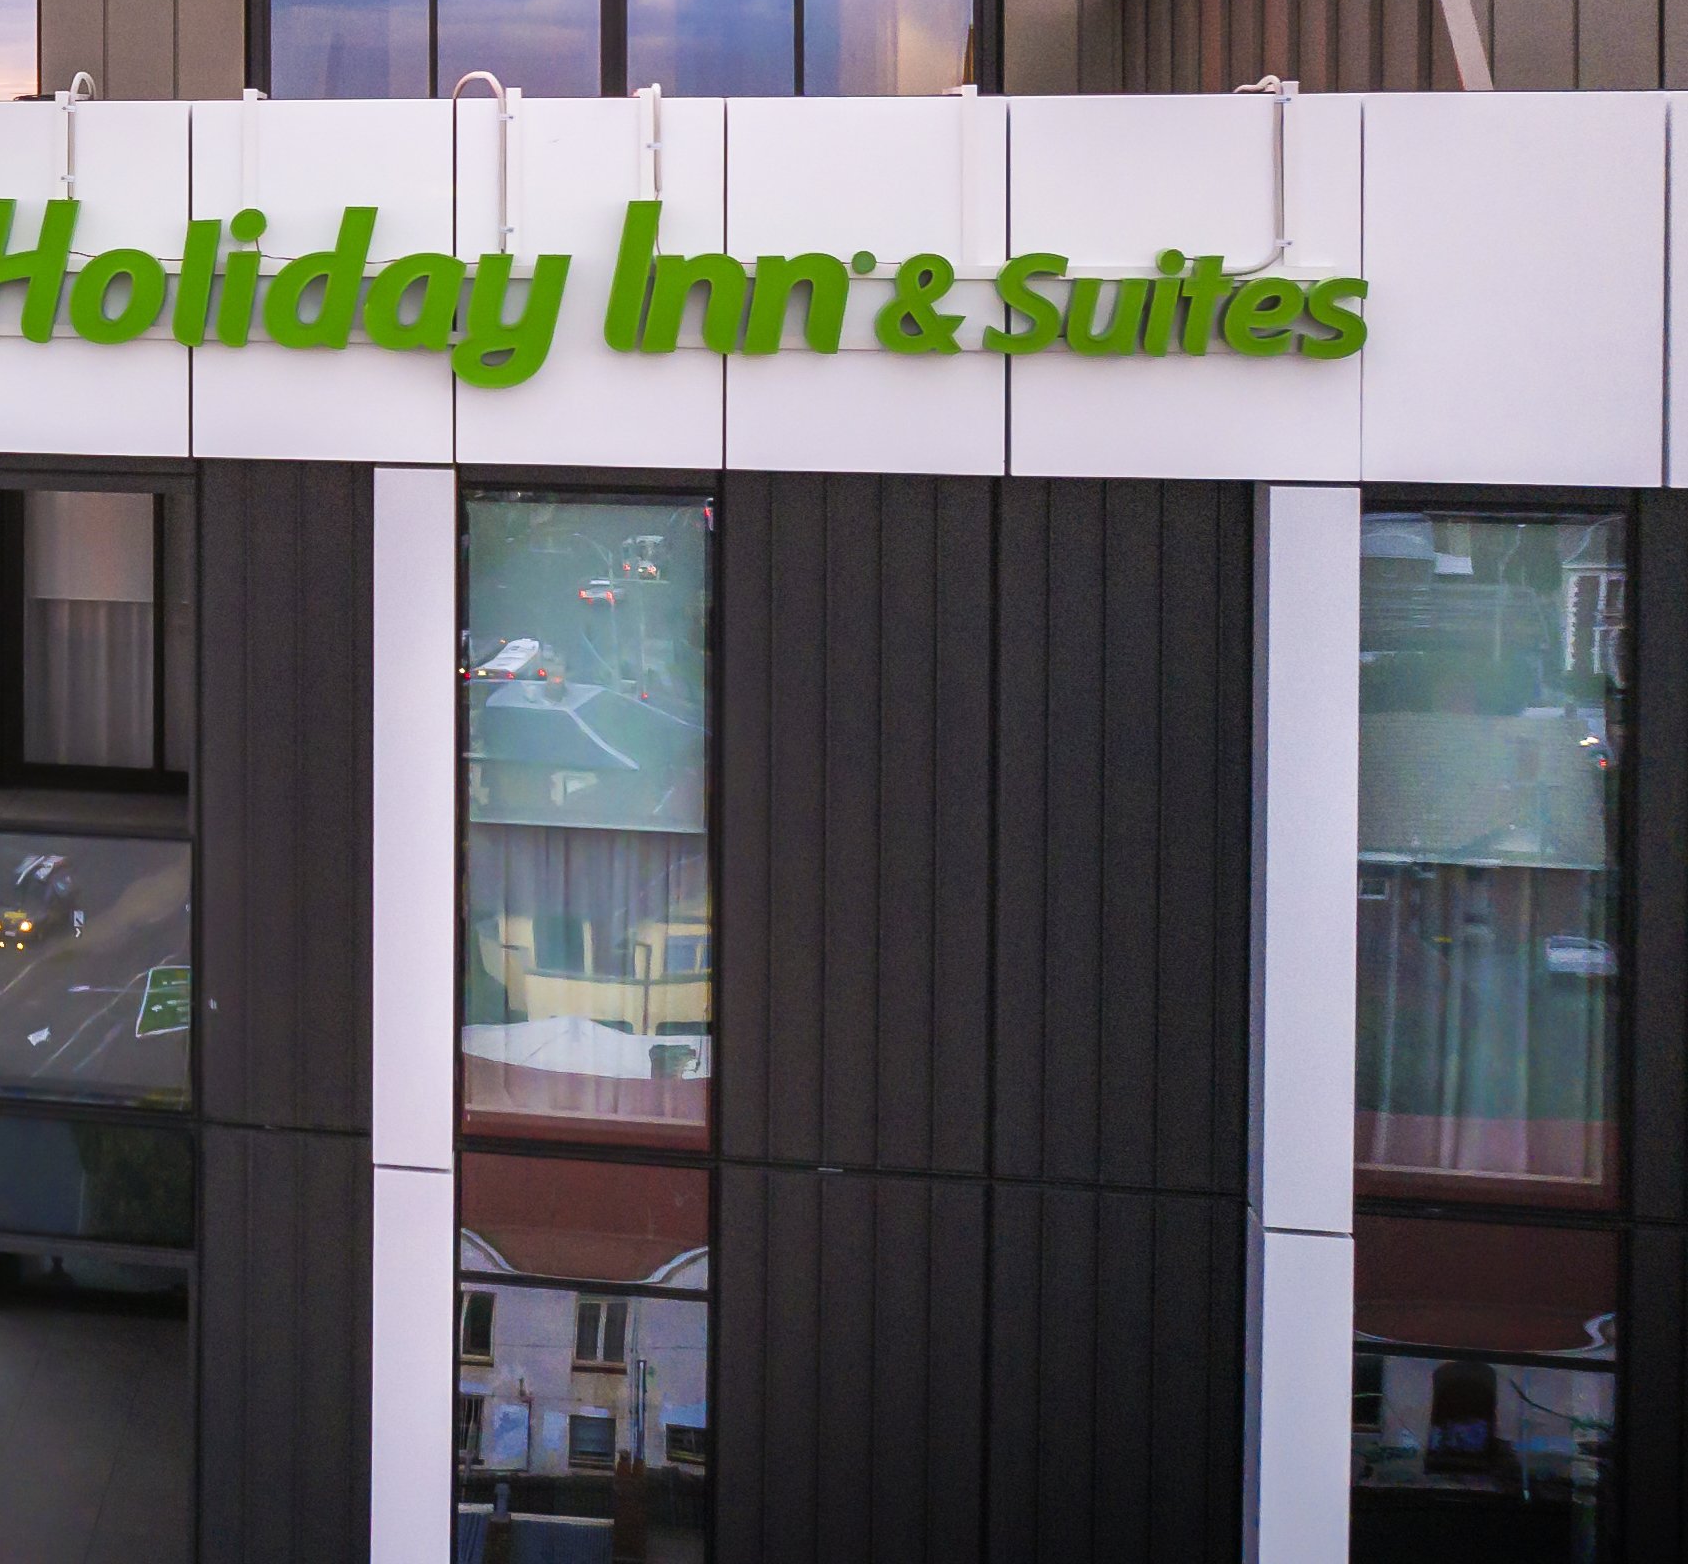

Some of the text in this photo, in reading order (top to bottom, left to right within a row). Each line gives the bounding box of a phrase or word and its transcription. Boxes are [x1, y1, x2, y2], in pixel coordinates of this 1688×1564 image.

[604, 200, 850, 356] Inn
[875, 253, 966, 356] &
[983, 248, 1369, 360] Suites
